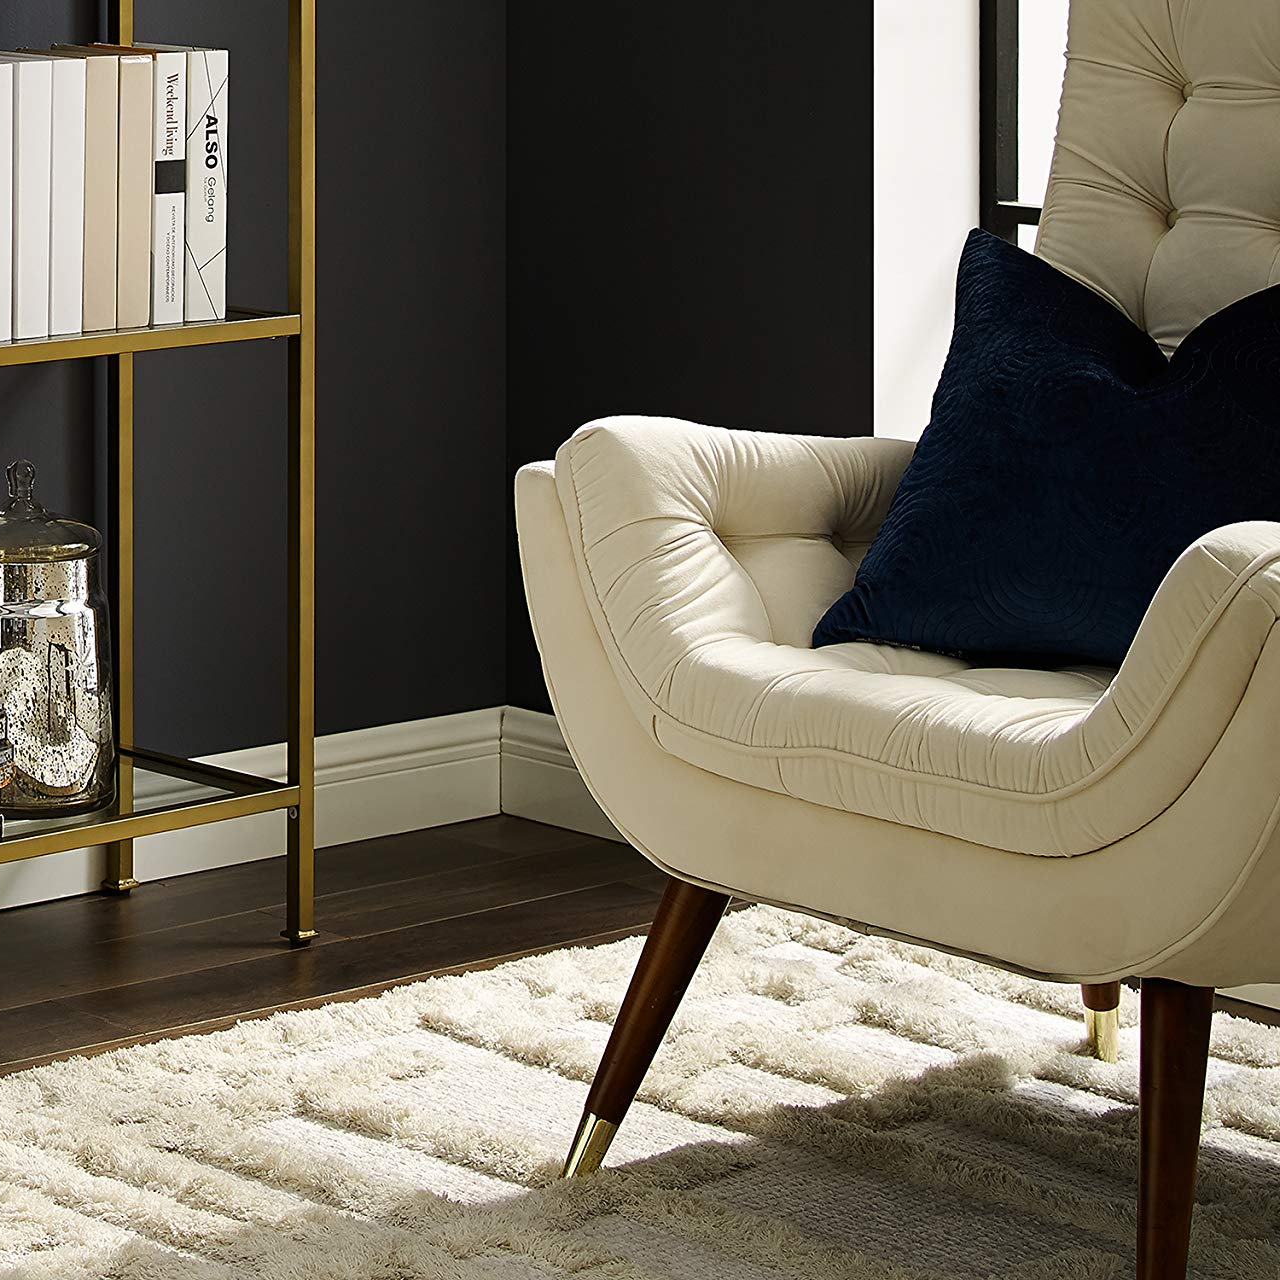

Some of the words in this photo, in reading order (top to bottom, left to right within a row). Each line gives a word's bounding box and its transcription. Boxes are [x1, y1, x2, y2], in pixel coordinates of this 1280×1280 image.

[165, 73, 179, 124] Weekend
[162, 124, 179, 157] living
[205, 114, 219, 170] ALSO
[205, 176, 217, 223] Gelang
